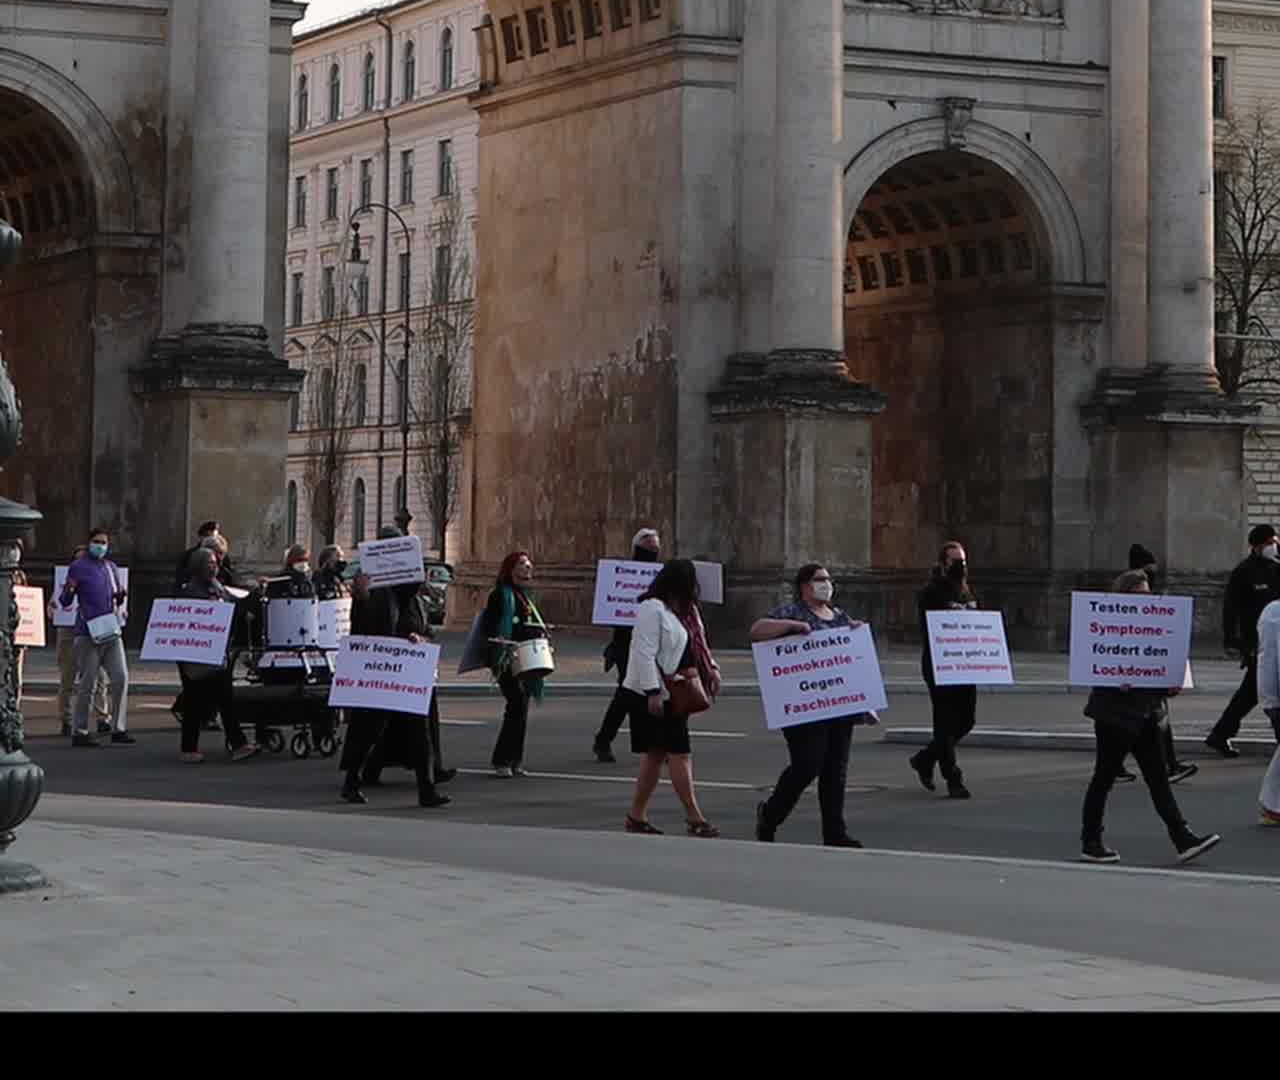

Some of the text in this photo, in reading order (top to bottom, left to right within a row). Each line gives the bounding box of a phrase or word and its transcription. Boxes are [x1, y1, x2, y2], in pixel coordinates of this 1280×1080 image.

[167, 603, 215, 615] Hört auf
[1089, 601, 1176, 616] Testen ohne
[188, 622, 227, 633] Kinder
[1089, 621, 1163, 637] Symptome
[349, 642, 427, 659] Wir leugnen
[775, 635, 851, 657] Für direkte
[1092, 643, 1169, 657] fördert den
[363, 662, 403, 673] nicht!
[771, 654, 853, 678] Demokratie
[1092, 663, 1167, 677] Lockdown!
[335, 677, 429, 695] Wir kritisieren!
[799, 676, 845, 692] Gegen
[783, 692, 867, 715] Faschismus
